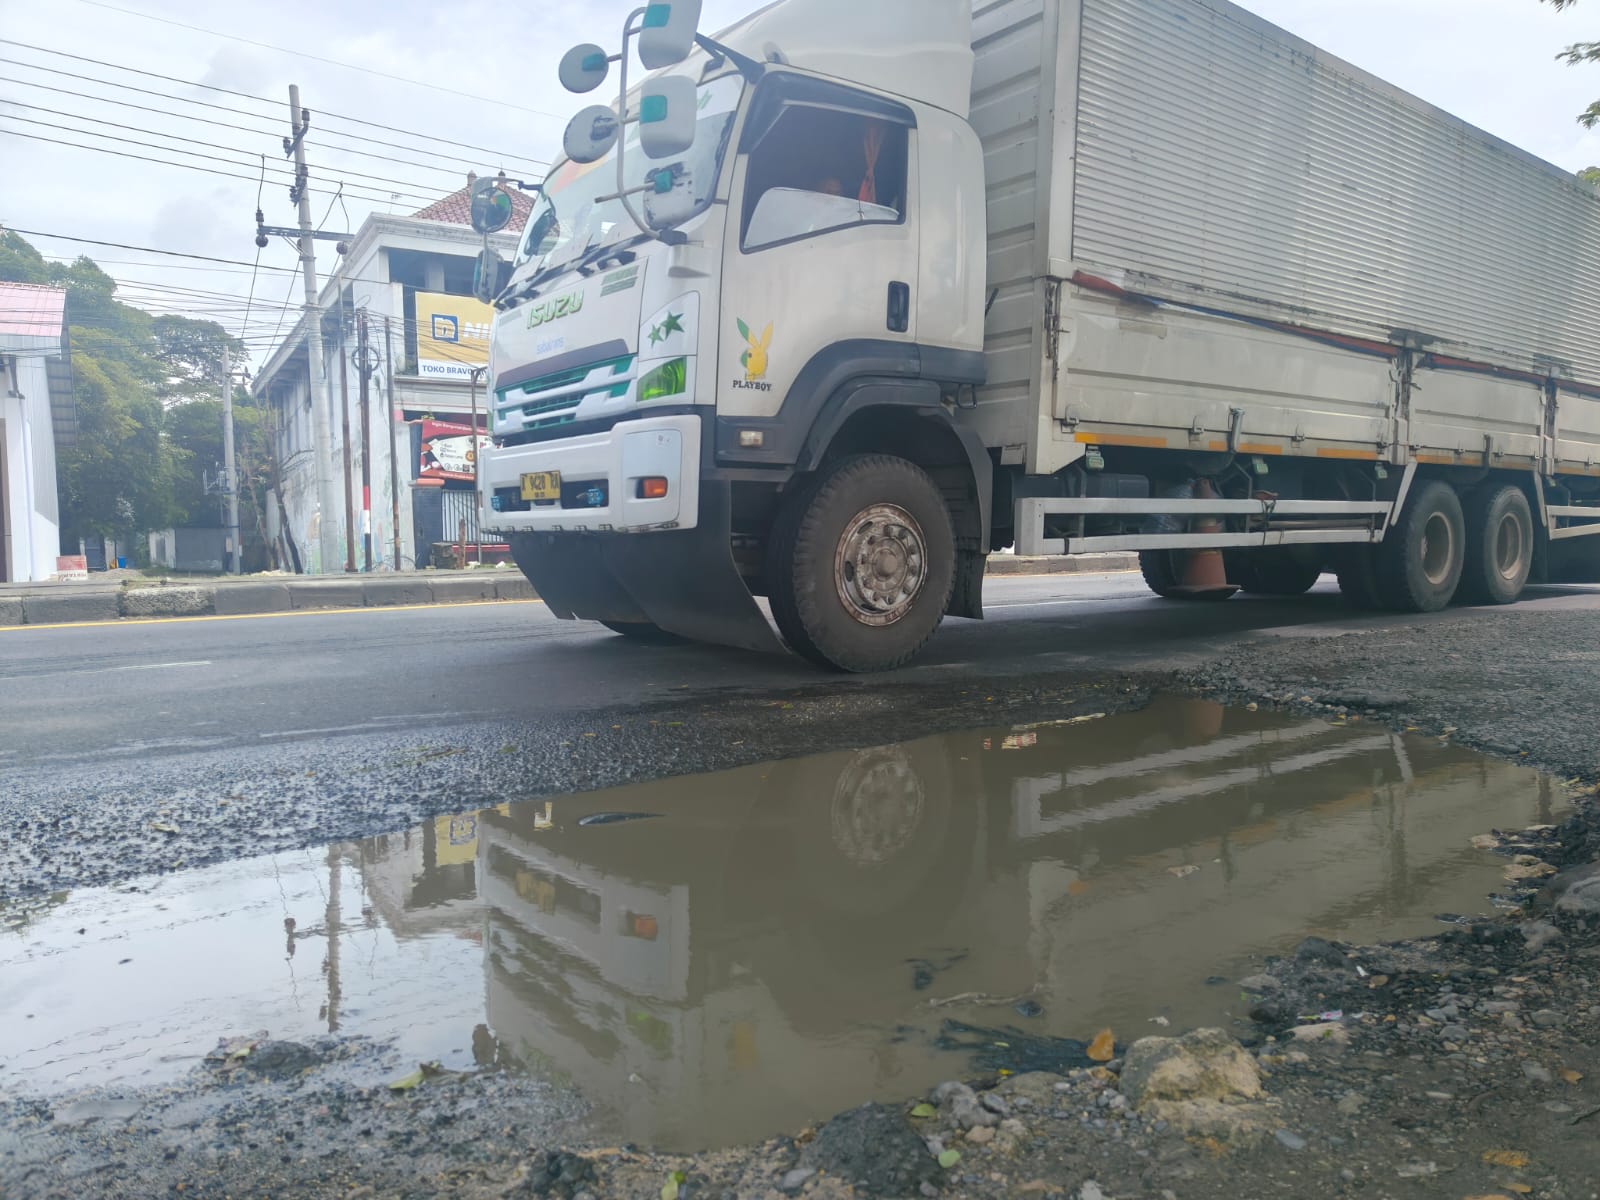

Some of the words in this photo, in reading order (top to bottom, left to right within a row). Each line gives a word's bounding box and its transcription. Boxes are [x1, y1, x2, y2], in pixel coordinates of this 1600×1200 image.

[527, 287, 585, 330] ISUZU
[422, 365, 445, 374] TOKO
[732, 380, 772, 391] PLAYBOY
